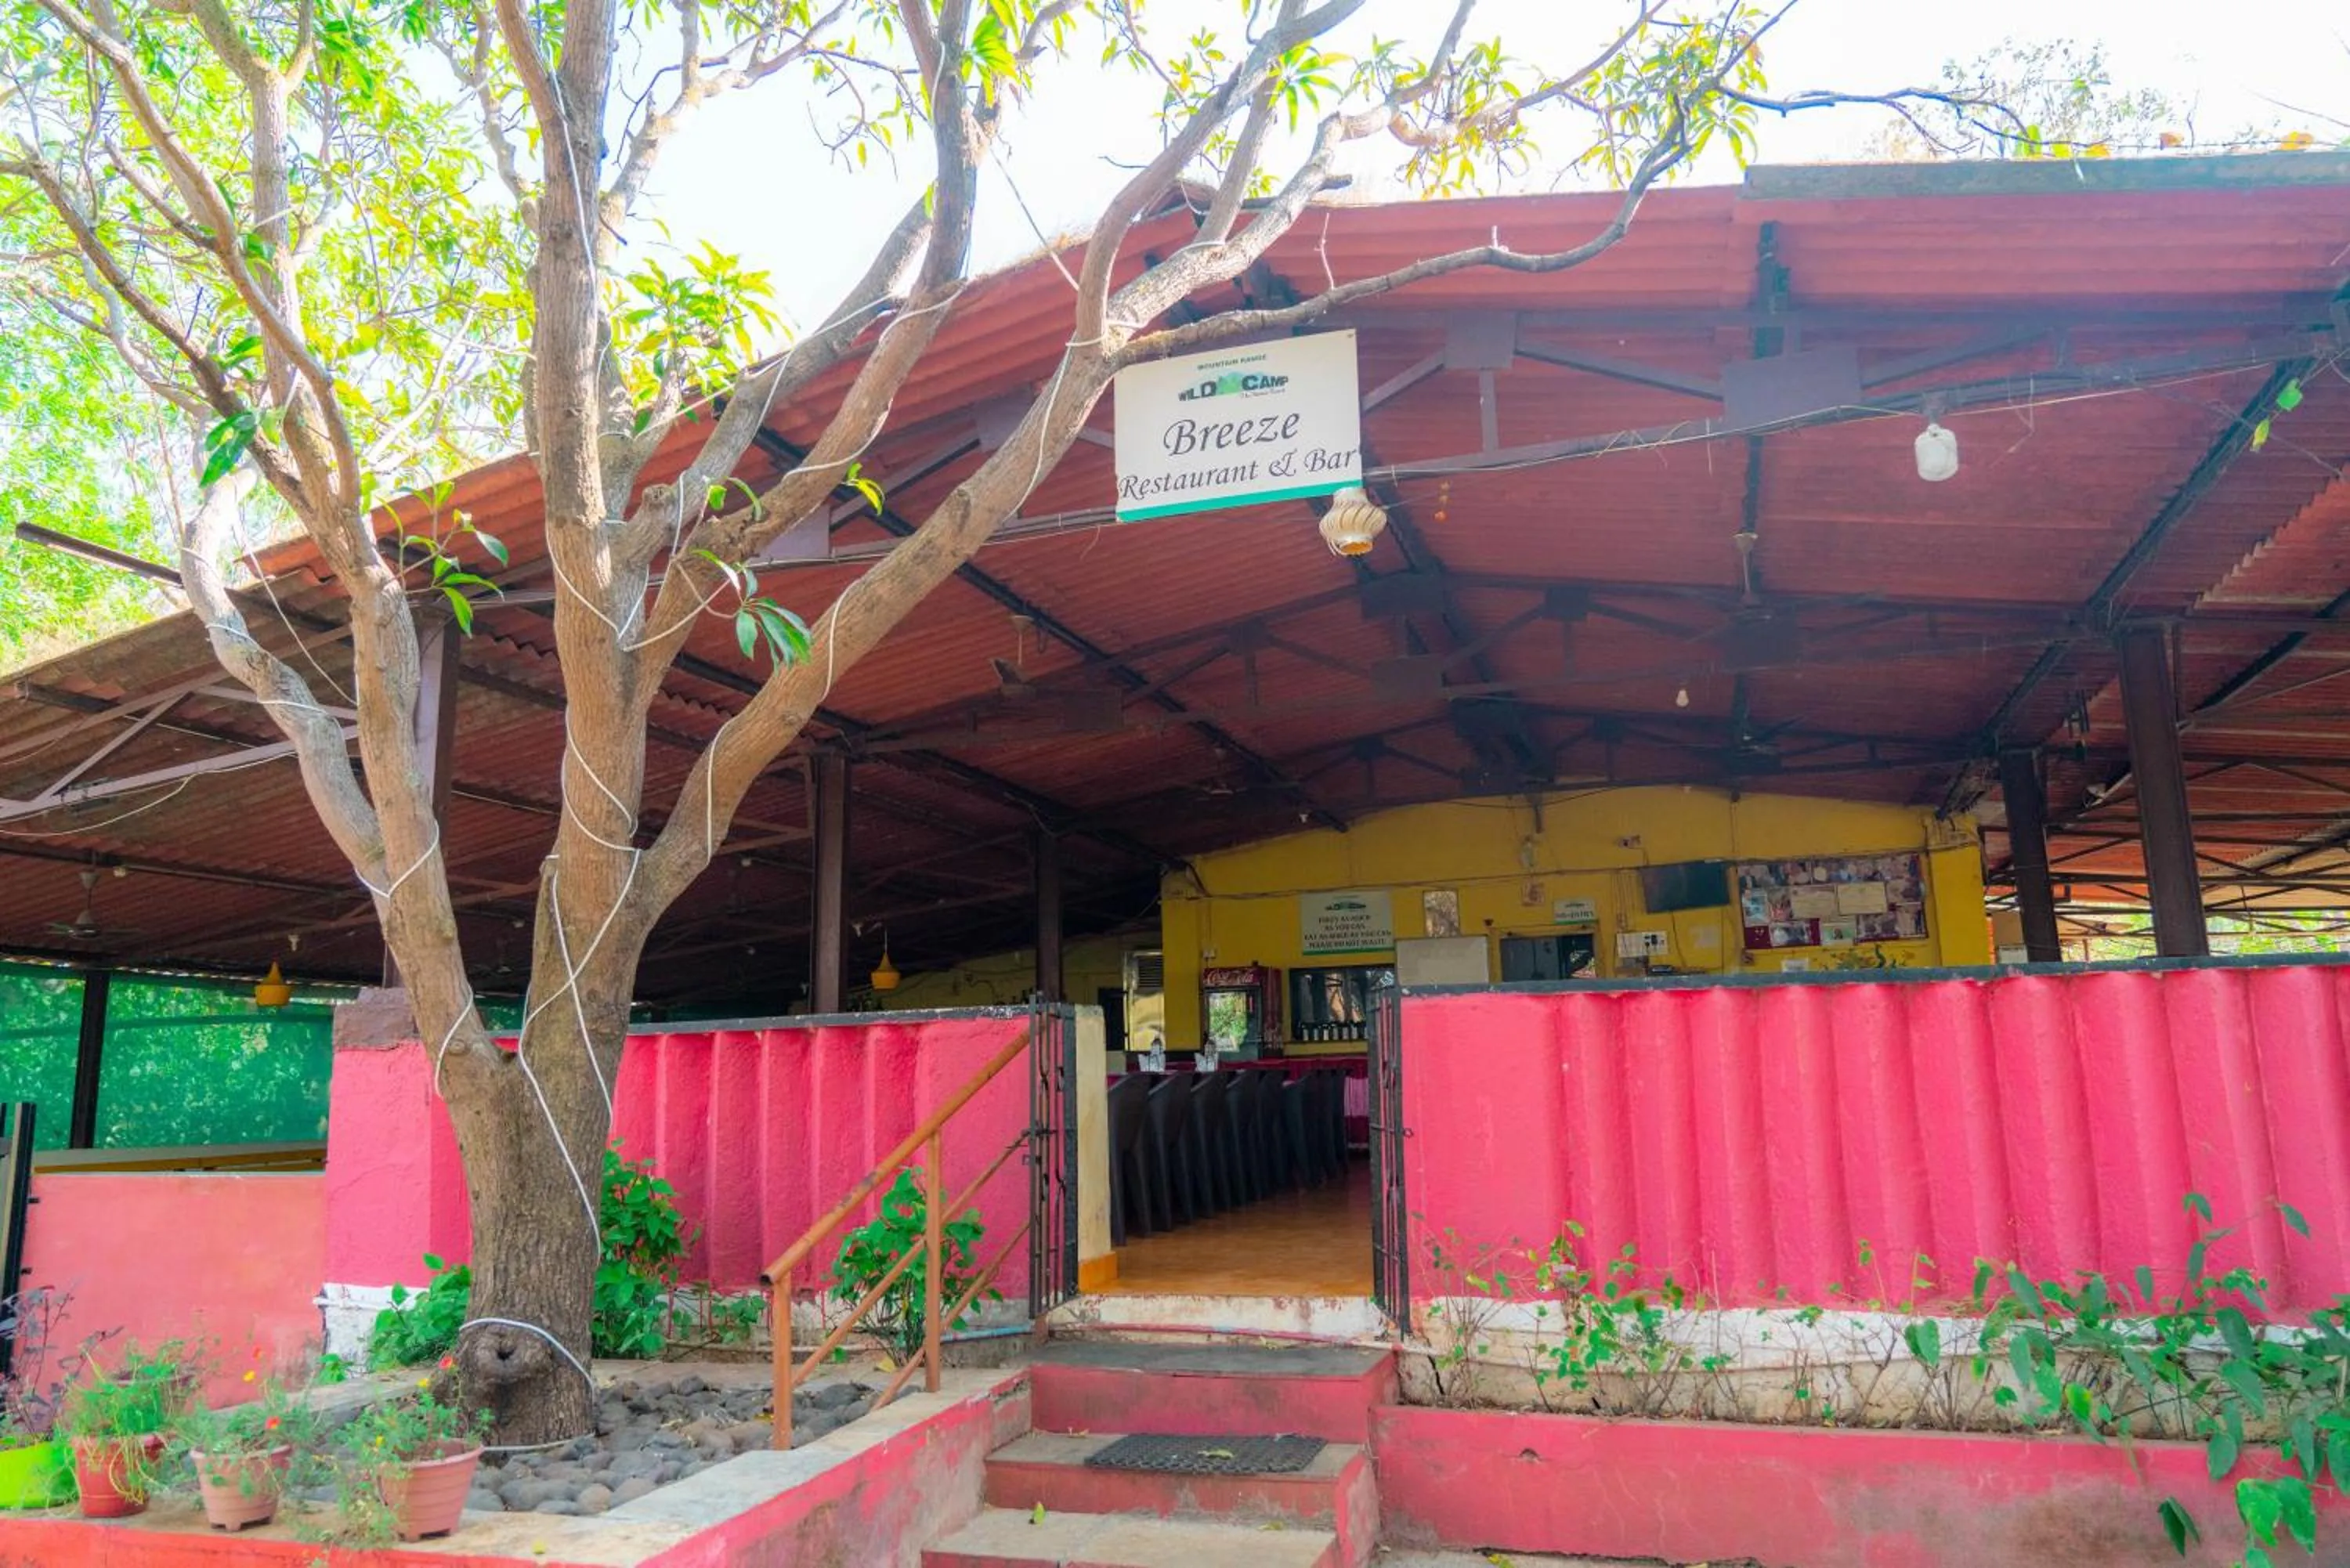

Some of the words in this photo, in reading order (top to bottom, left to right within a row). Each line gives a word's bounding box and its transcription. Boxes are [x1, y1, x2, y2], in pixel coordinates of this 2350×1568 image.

[1242, 375, 1289, 390] CAMP
[1162, 413, 1300, 457] Breeze
[1119, 461, 1259, 500] Restaurant
[1268, 449, 1296, 477] &
[1304, 448, 1357, 472] Bar
